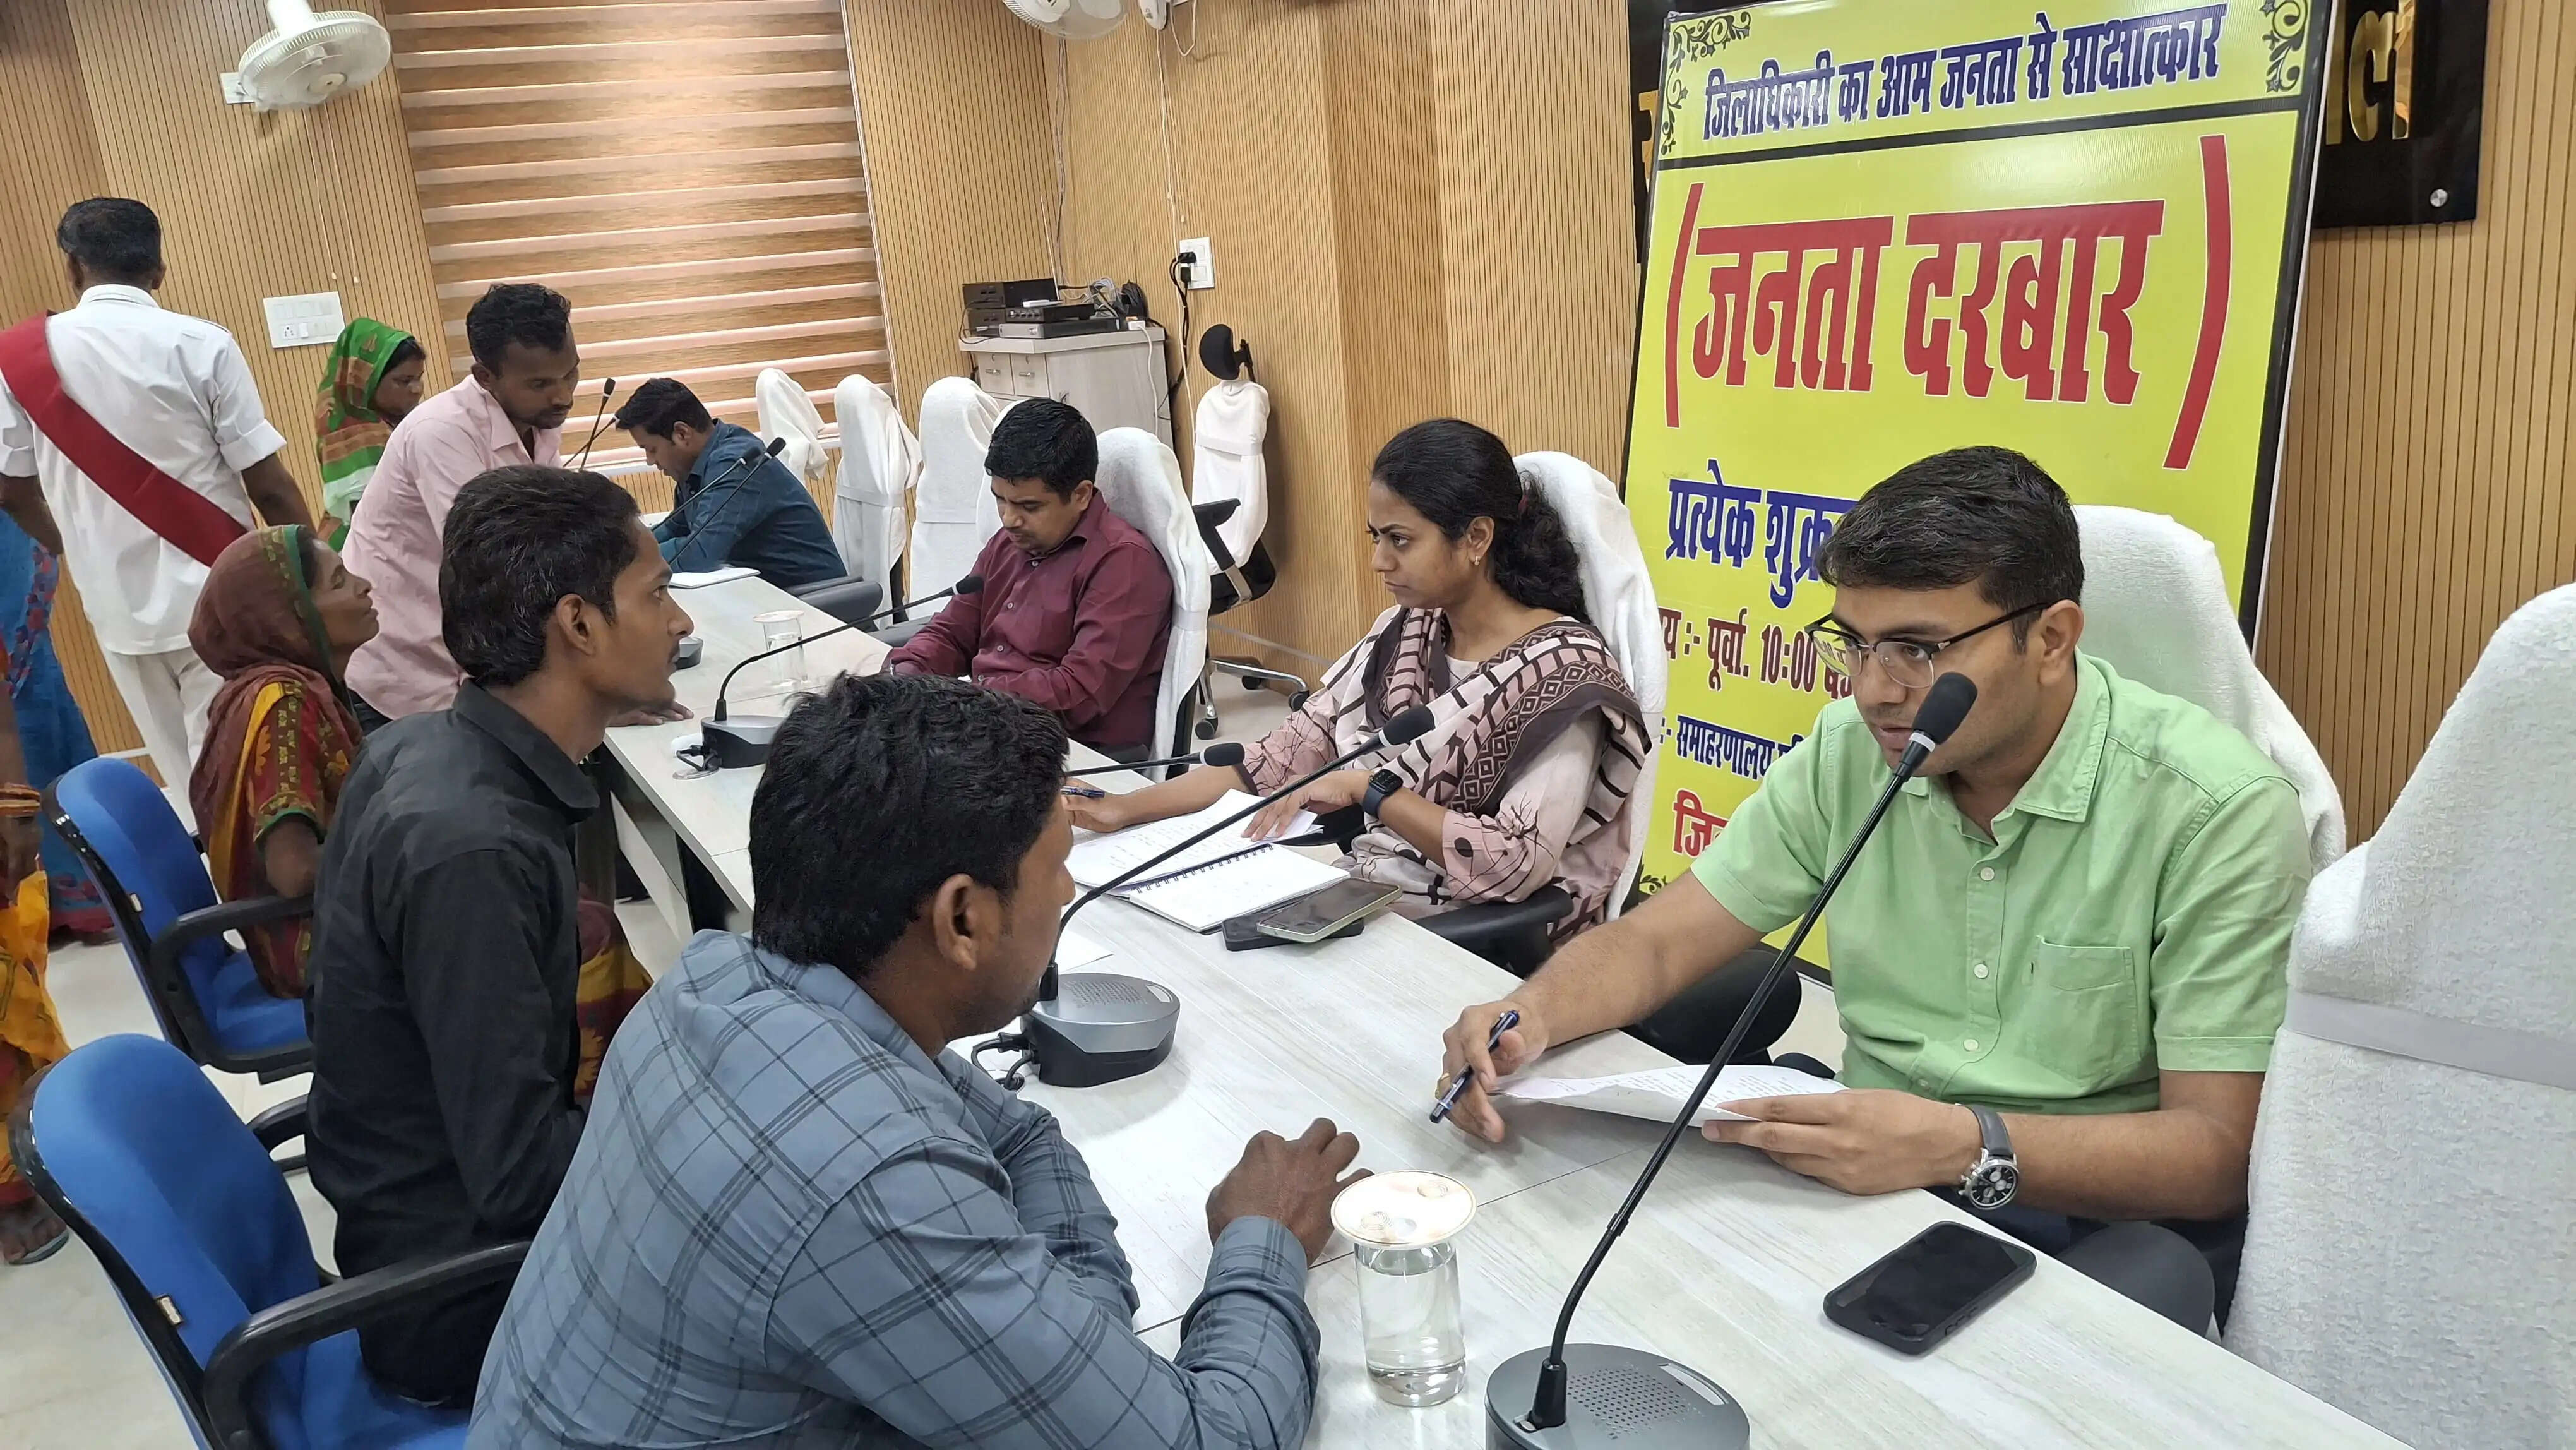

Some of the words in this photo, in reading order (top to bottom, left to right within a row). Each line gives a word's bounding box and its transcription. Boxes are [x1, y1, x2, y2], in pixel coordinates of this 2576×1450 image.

[1703, 49, 1835, 140] जिलाधिकारी
[1838, 60, 1875, 123] का
[1876, 51, 1937, 119] आम
[1940, 36, 2024, 109] जनता
[2027, 11, 2058, 100] से
[2061, 3, 2229, 97] साक्षात्कार
[1665, 458, 1763, 569] प्रत्येक
[1765, 489, 1859, 609] शुक्र
[1760, 624, 1818, 693] 10:00
[1673, 789, 1729, 857] जि
